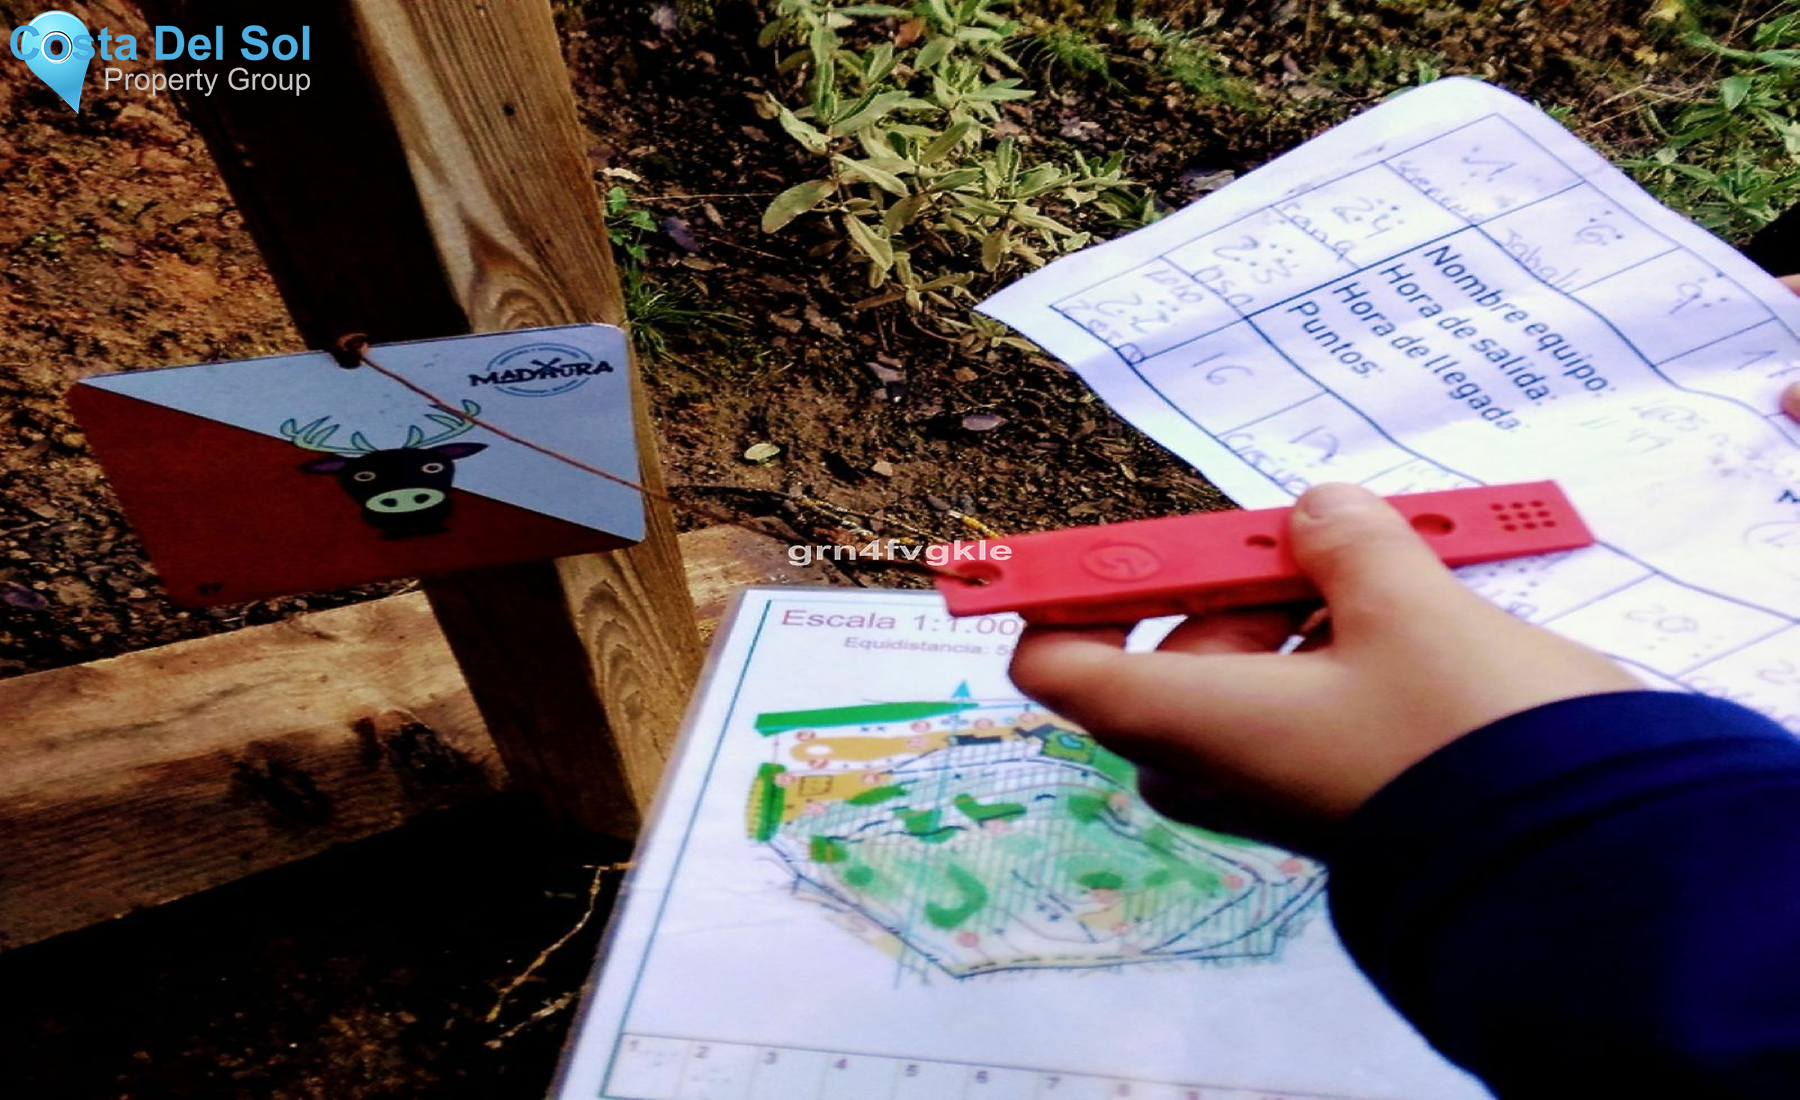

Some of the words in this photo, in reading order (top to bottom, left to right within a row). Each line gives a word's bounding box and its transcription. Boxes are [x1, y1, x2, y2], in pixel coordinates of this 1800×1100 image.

[1287, 301, 1385, 379] Puntos:
[1332, 282, 1396, 337] Hora
[1390, 334, 1431, 359] de
[1379, 263, 1443, 318] Hora
[1437, 317, 1478, 339] de
[1471, 338, 1558, 406] salida:
[1424, 245, 1528, 324] Nombre
[1524, 322, 1616, 397] equipo:
[1192, 352, 1254, 385] 16
[781, 608, 896, 630] Escala
[913, 614, 1020, 636] 1:1.00
[844, 636, 988, 656] Equidistancia:
[696, 1046, 710, 1059] 2
[764, 1051, 778, 1065] 3
[833, 1058, 848, 1070] 4
[905, 1064, 918, 1078] 5
[976, 1070, 989, 1084] 6
